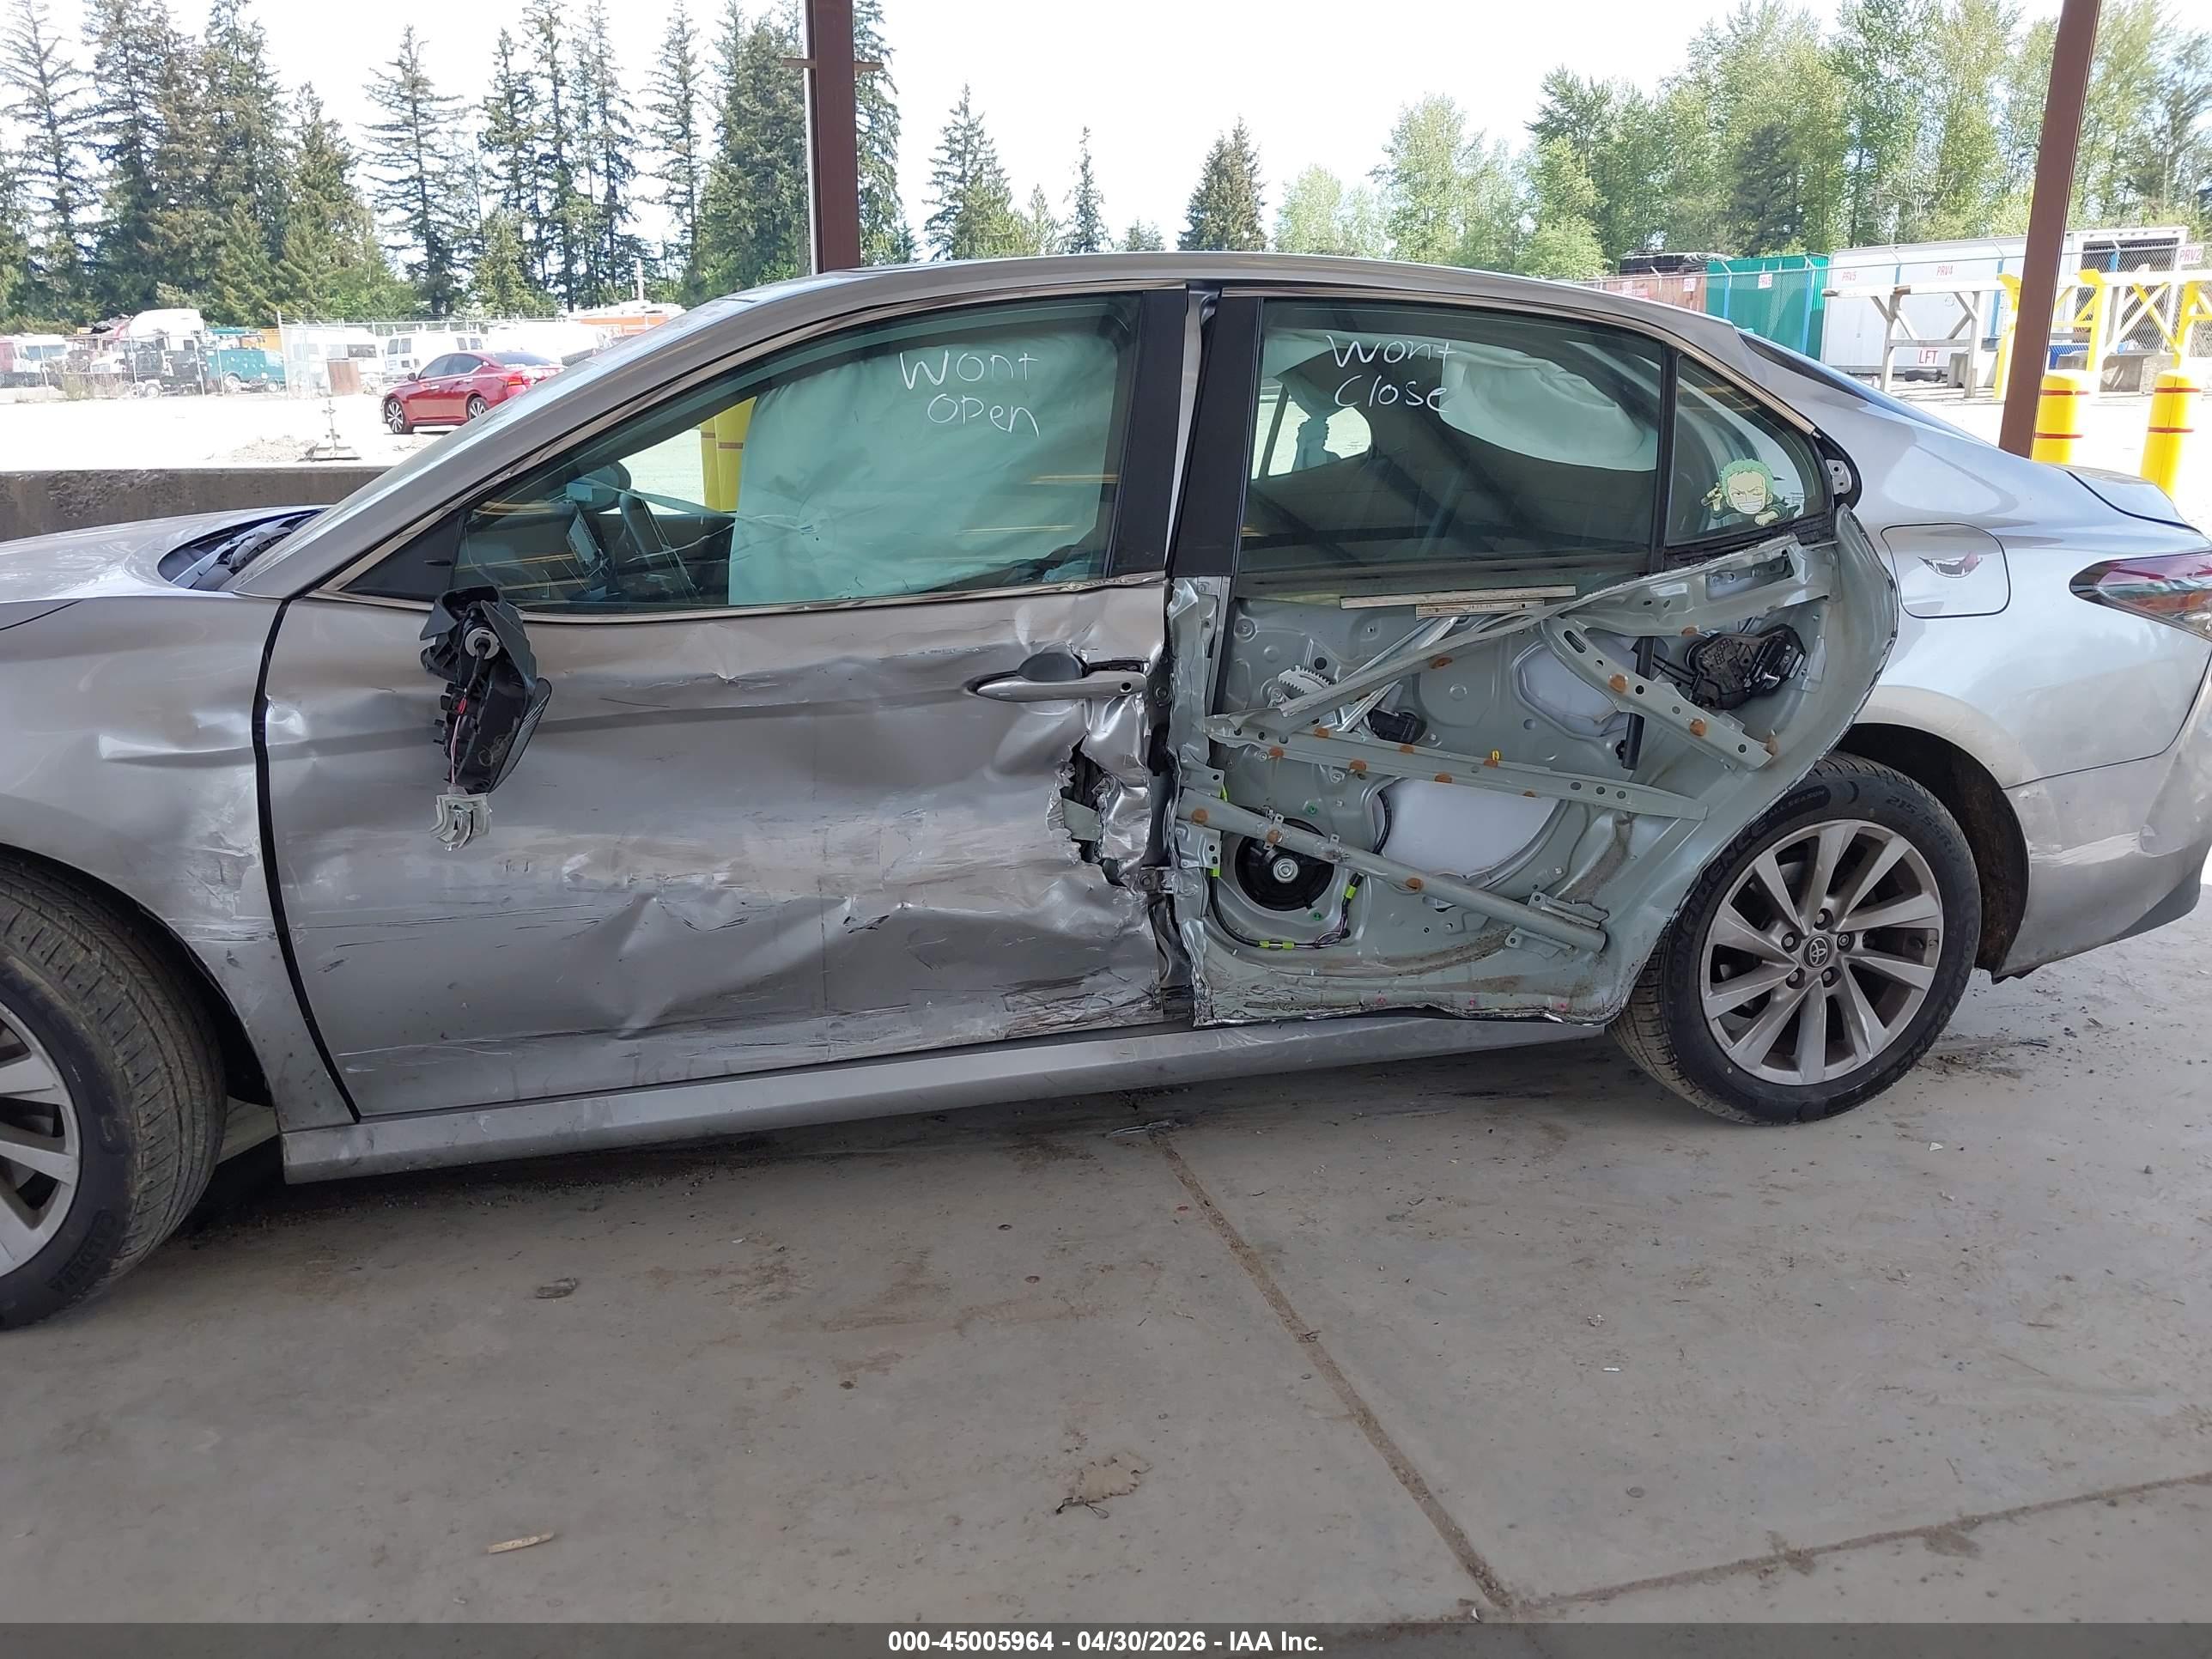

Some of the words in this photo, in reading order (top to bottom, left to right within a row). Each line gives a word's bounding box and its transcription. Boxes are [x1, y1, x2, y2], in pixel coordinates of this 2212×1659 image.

[2179, 248, 2202, 262] PRV2
[1936, 264, 1954, 276] PRV4
[1918, 349, 1939, 364] LFT
[1334, 374, 1450, 413] Close
